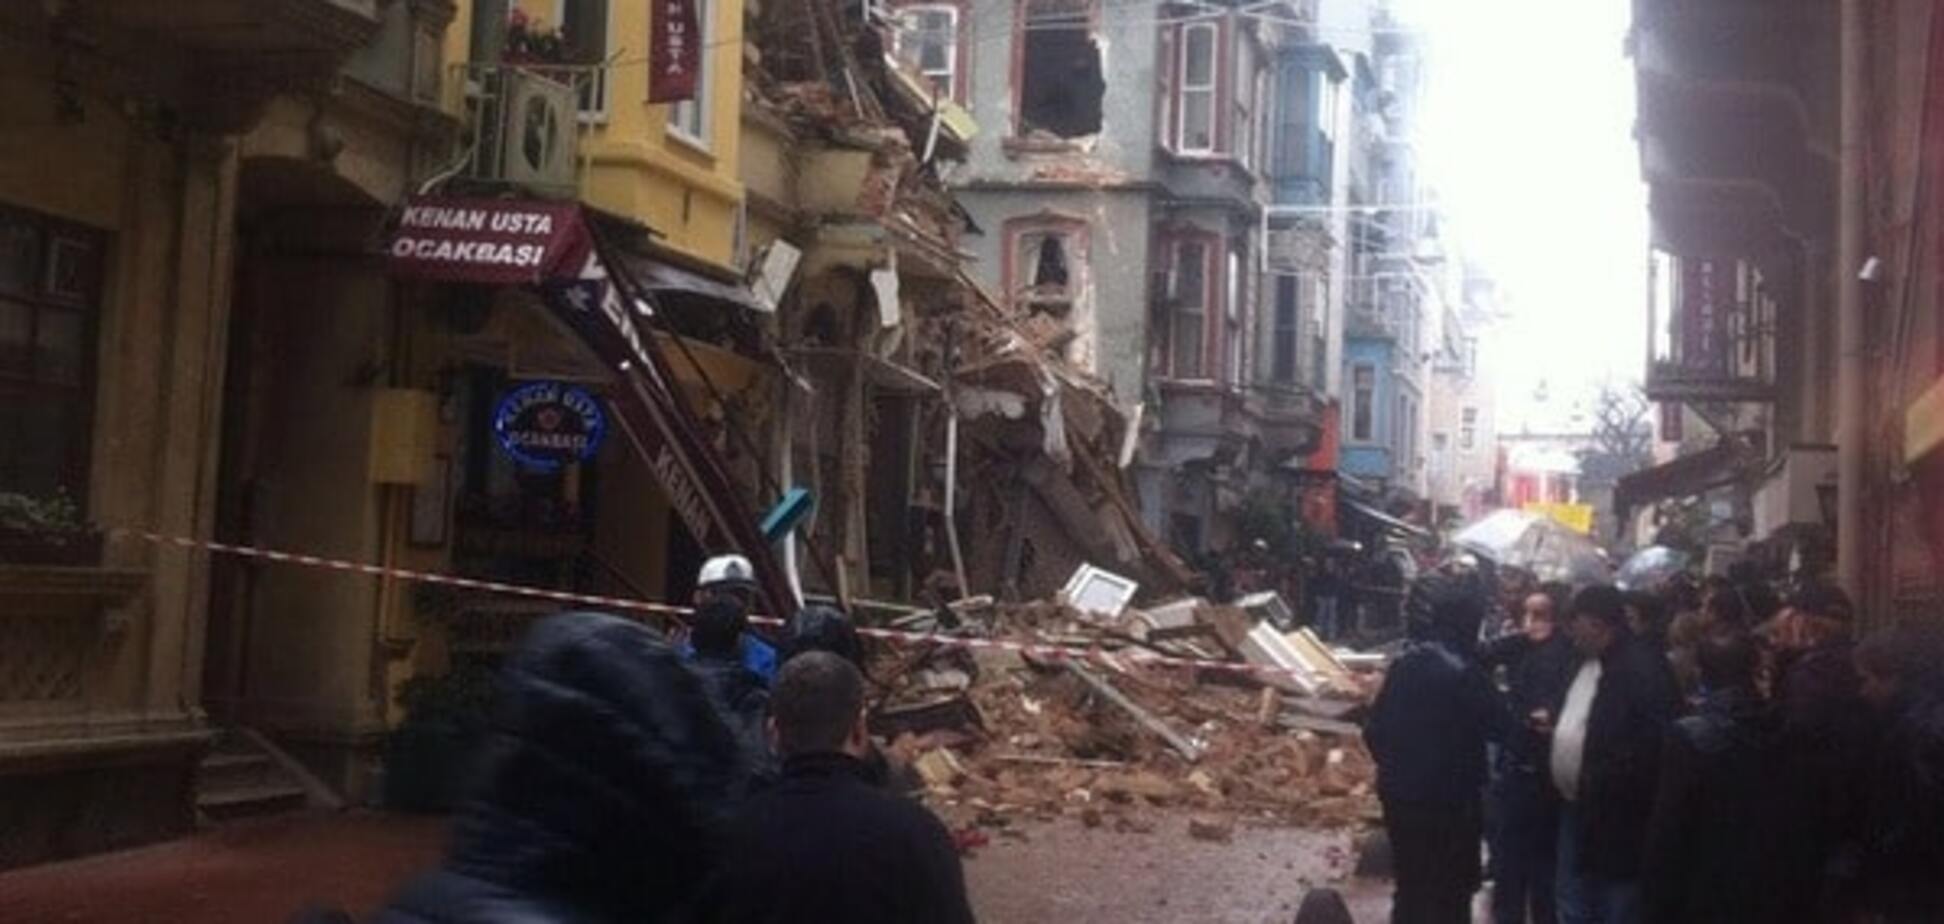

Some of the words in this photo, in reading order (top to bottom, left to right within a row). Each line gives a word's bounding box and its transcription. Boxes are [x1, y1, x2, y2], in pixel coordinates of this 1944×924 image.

[665, 21, 686, 76] USTA
[400, 205, 487, 232] KENAN
[490, 210, 553, 236] USTA
